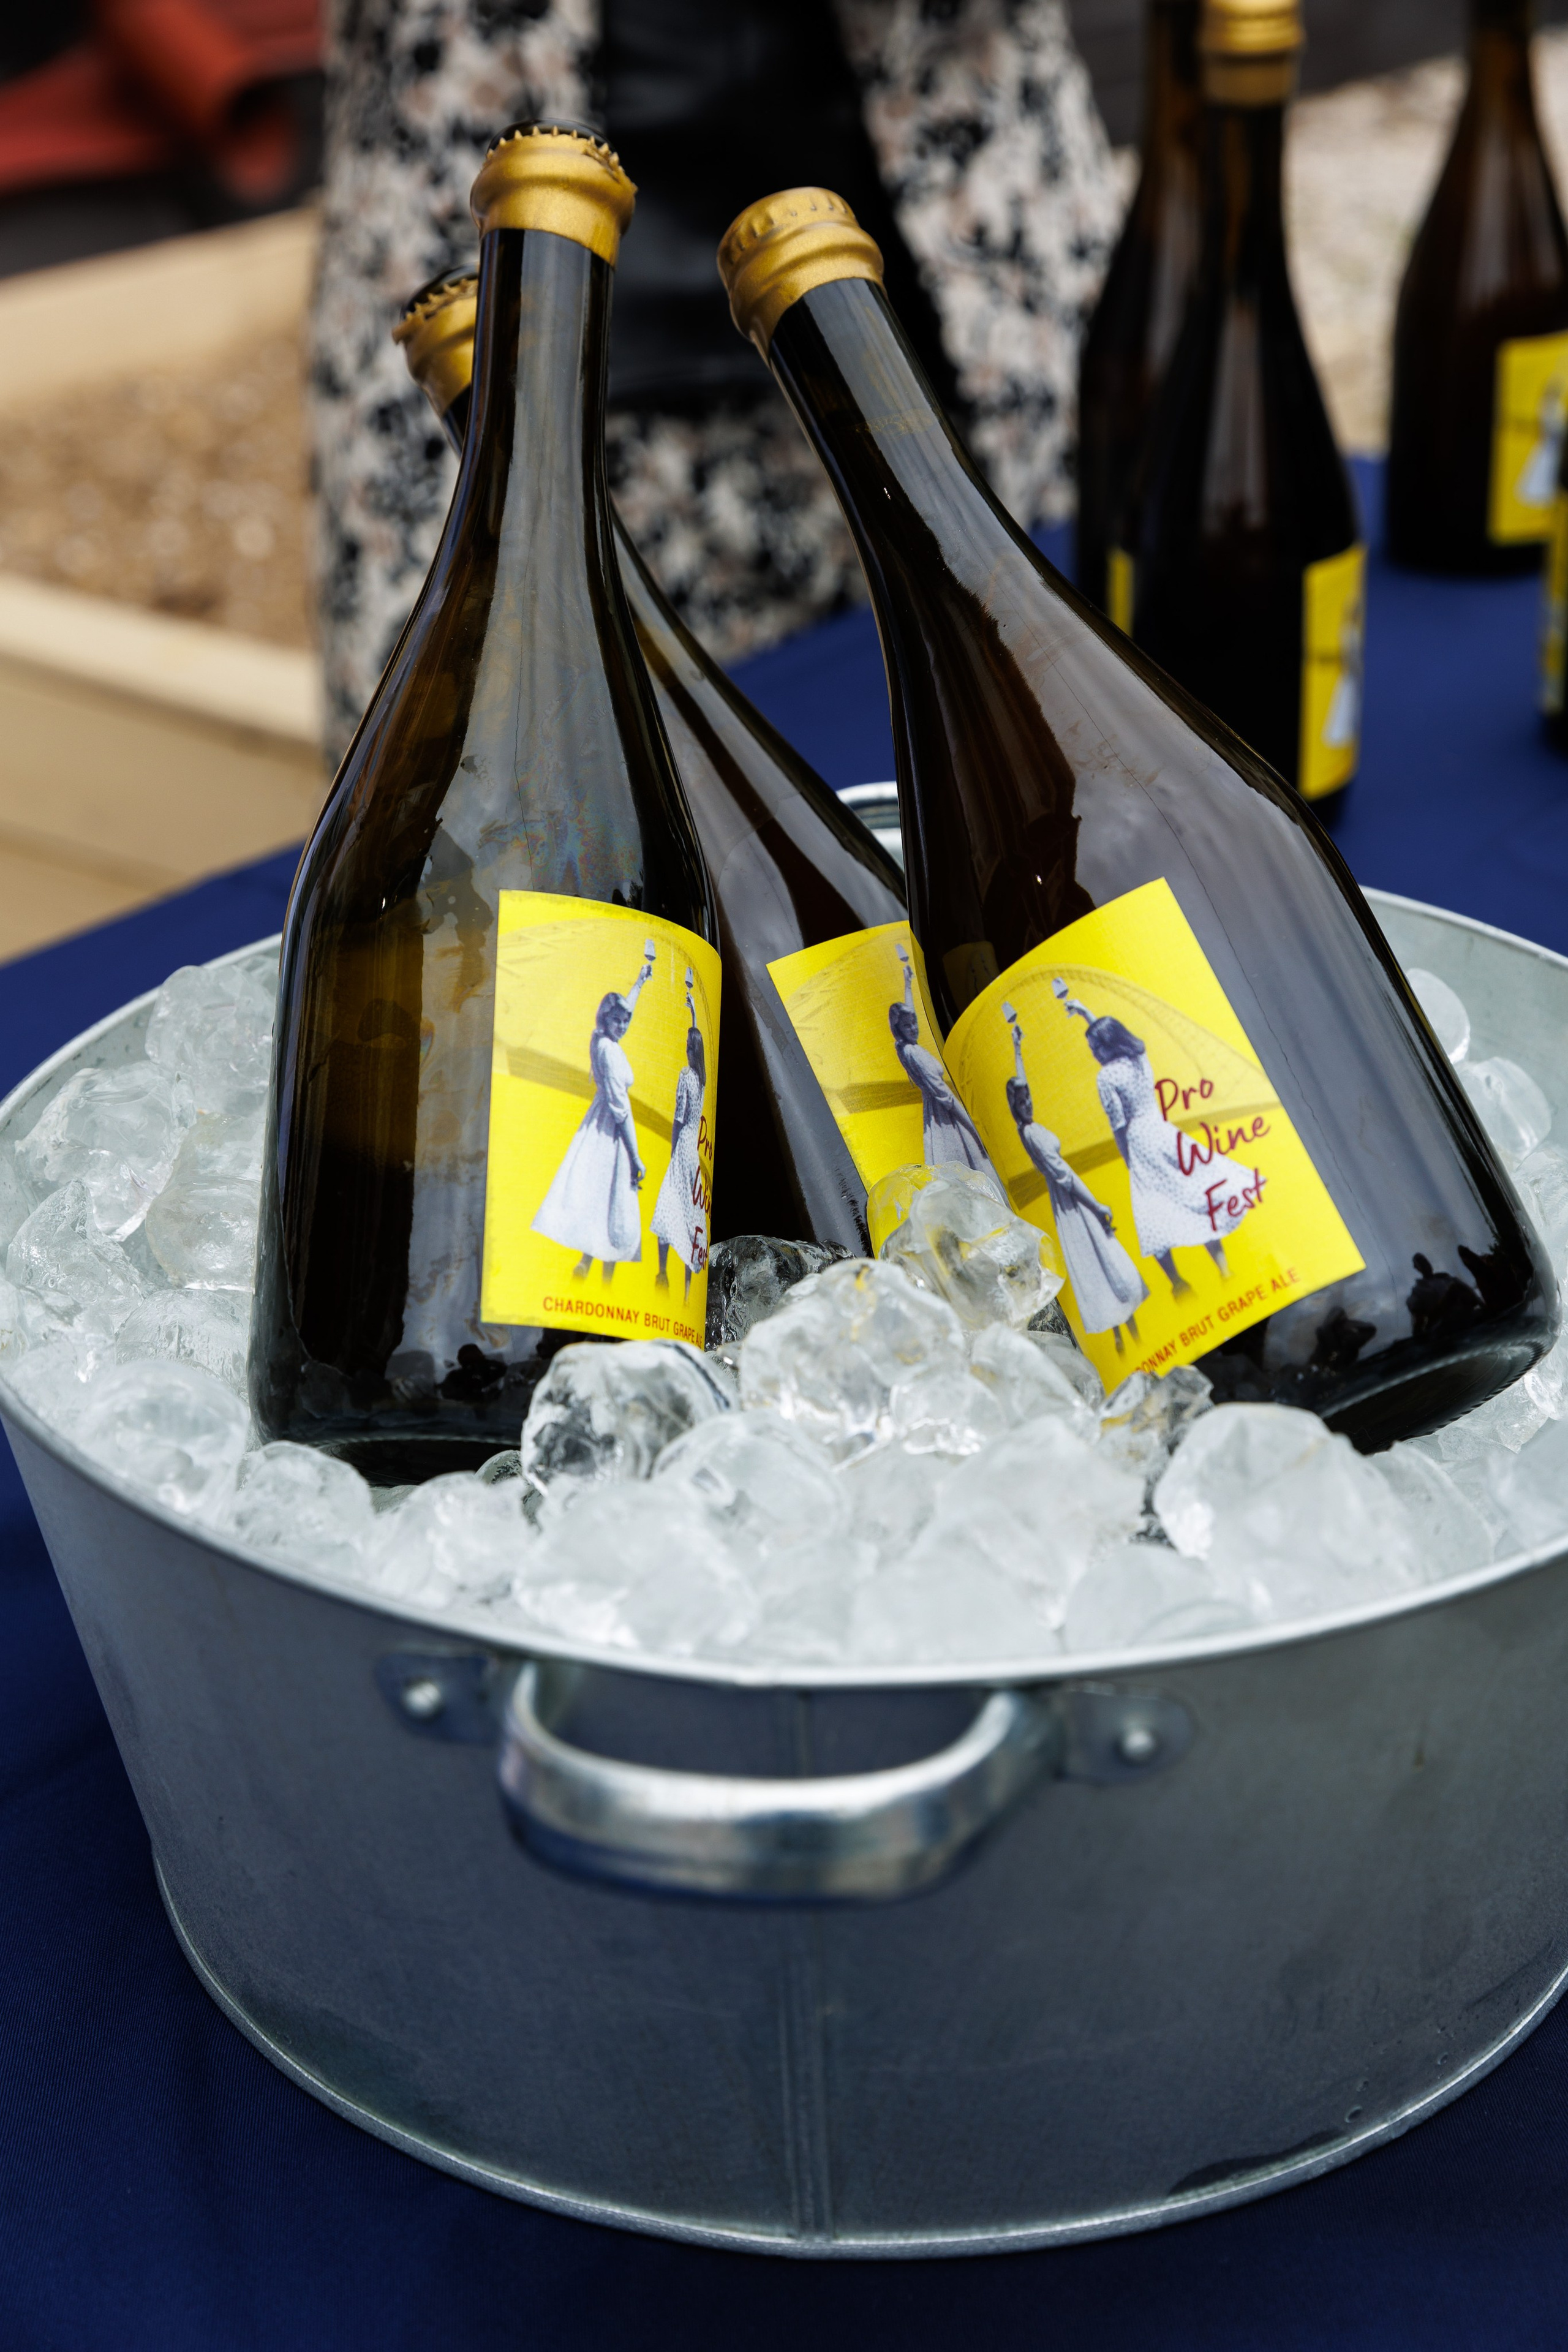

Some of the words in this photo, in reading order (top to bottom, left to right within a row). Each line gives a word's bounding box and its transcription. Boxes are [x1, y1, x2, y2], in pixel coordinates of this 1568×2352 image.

[1155, 1078, 1213, 1121] Pro
[697, 1115, 713, 1161] Pro
[1177, 1117, 1271, 1176] Wine
[693, 1165, 712, 1219] Win
[1205, 1167, 1267, 1231] Fest
[543, 1295, 639, 1324] CHARDONNAY
[644, 1313, 671, 1333] BRUT
[673, 1321, 695, 1344] GRAPE
[1179, 1314, 1215, 1347] BRUT
[1216, 1284, 1267, 1323] GRAPE
[1270, 1267, 1301, 1293] ALE
